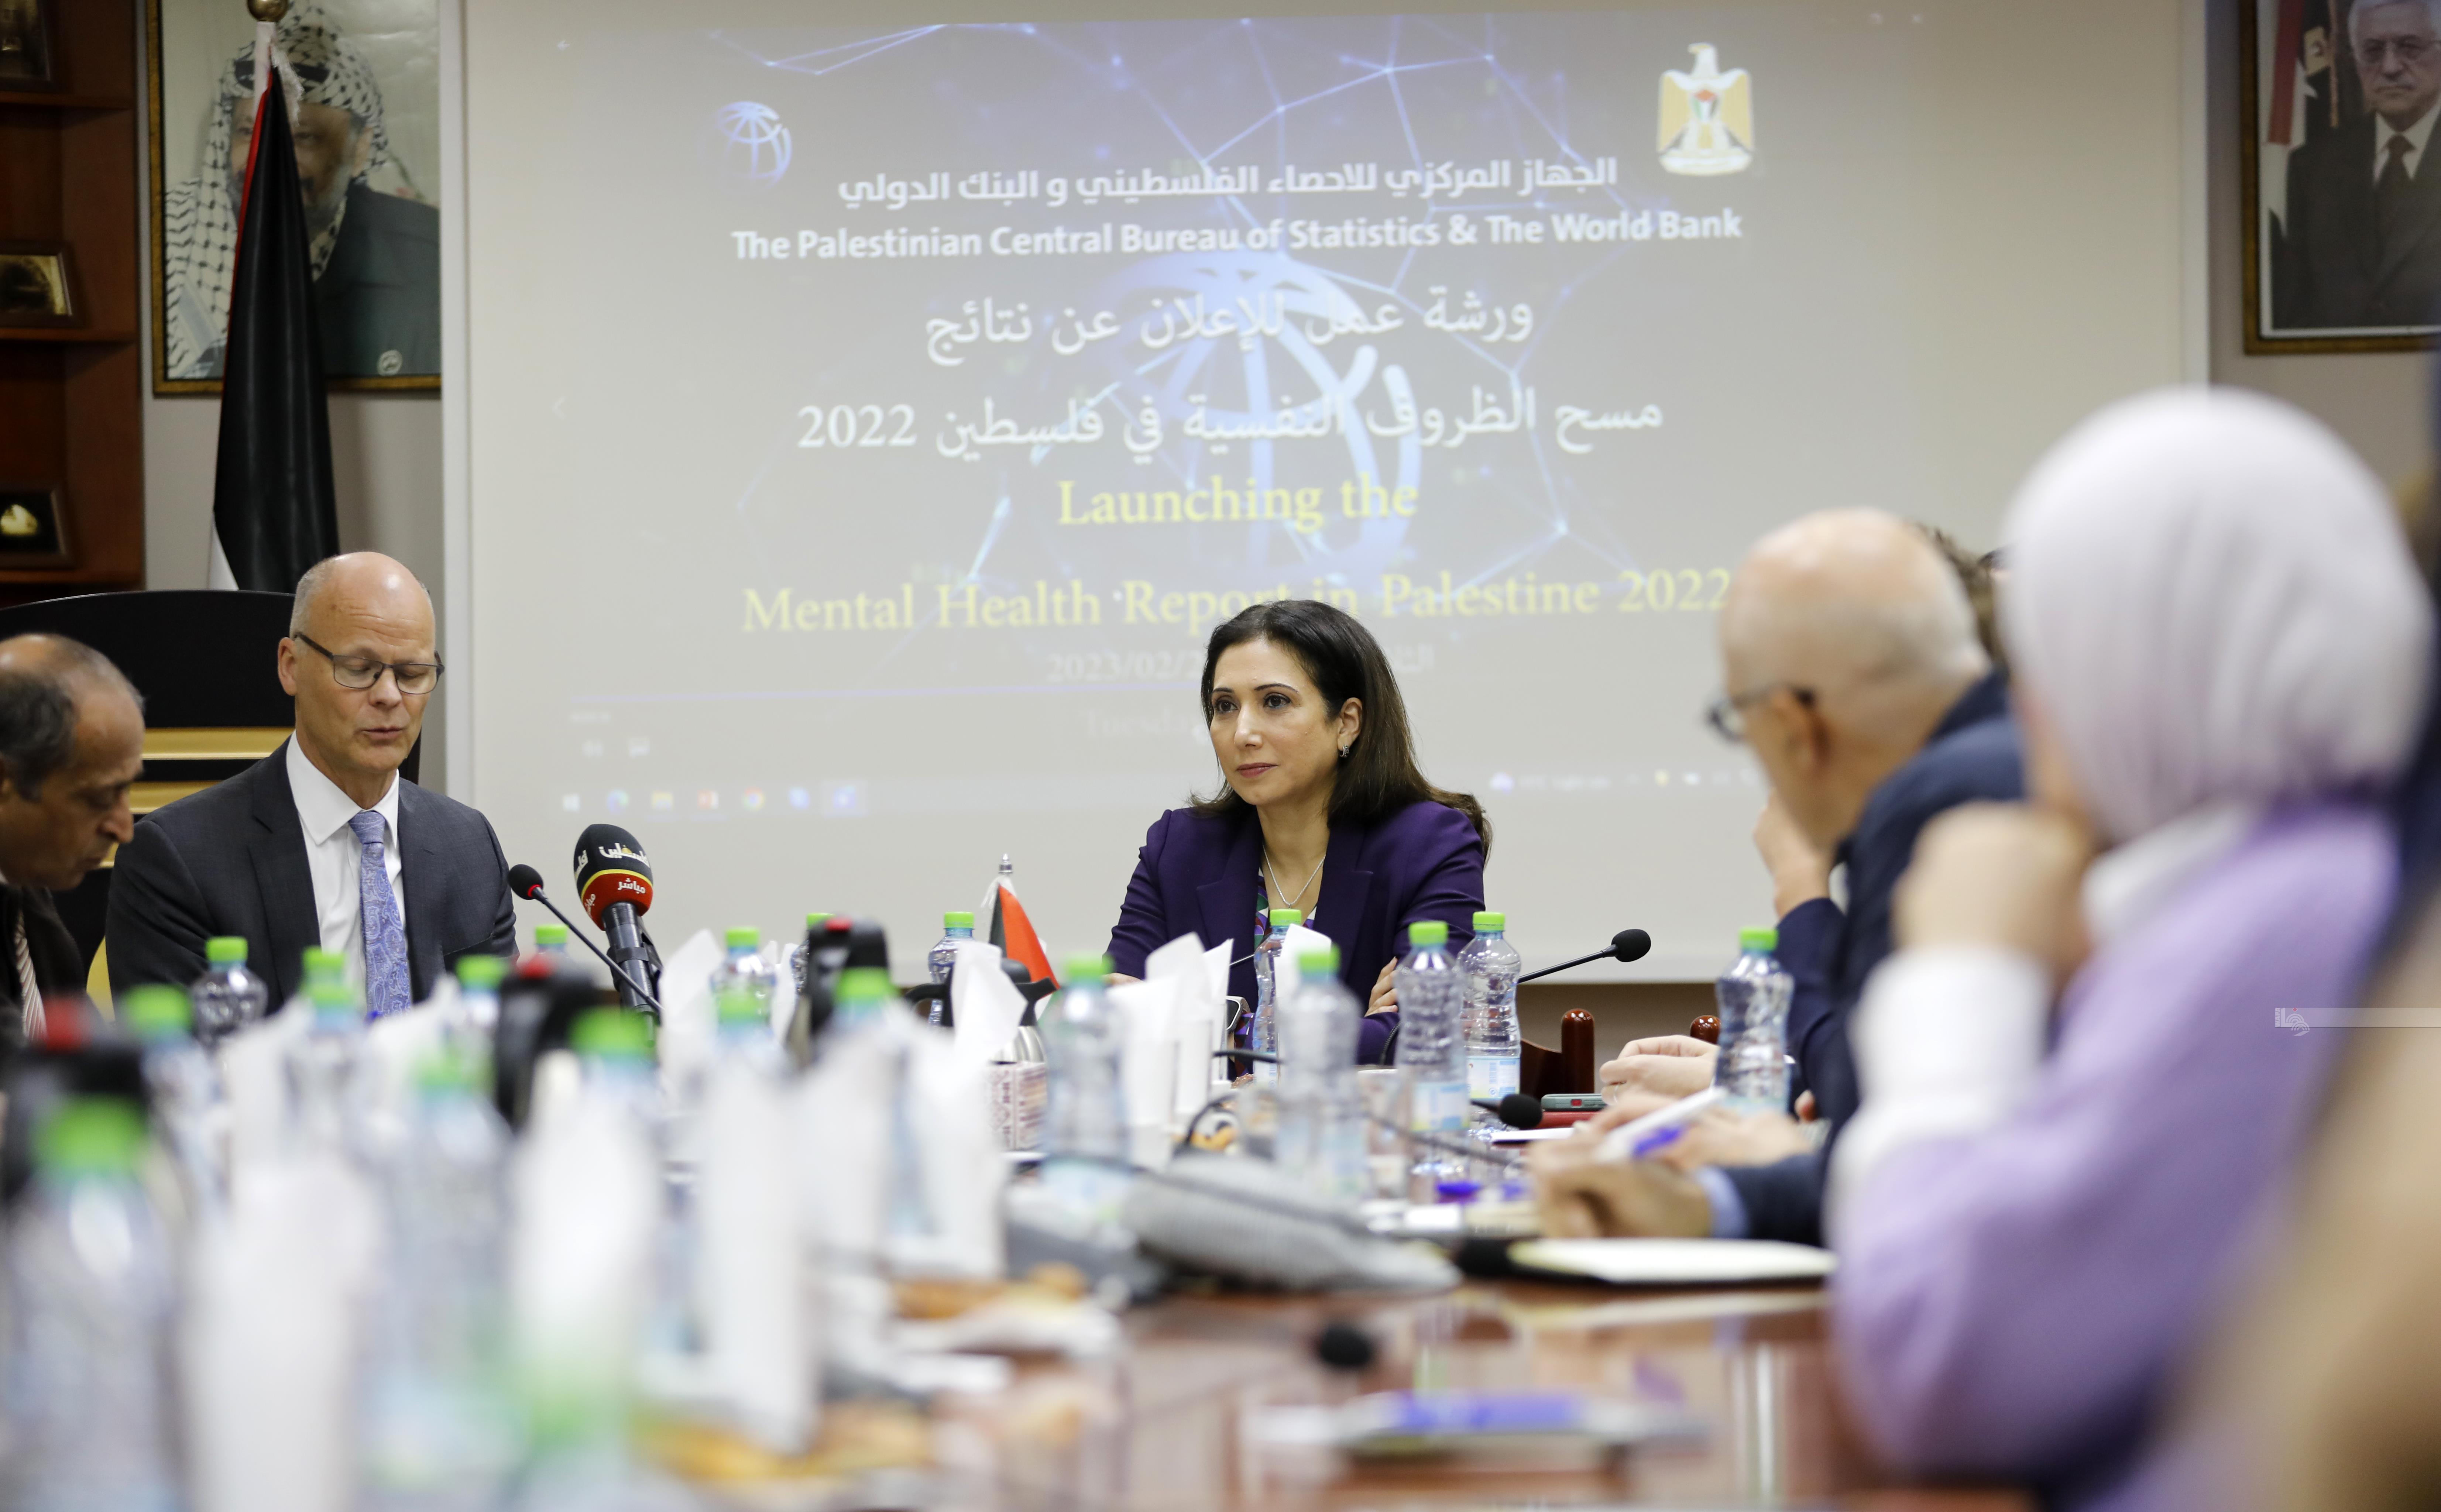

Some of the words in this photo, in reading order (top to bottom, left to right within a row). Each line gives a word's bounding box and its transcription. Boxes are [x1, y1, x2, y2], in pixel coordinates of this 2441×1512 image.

[839, 172, 948, 209] الدولي
[958, 171, 1037, 205] البنك
[1047, 178, 1067, 205] و
[1078, 165, 1257, 203] الفلسطيني
[1268, 164, 1376, 193] للاحصاء
[1384, 161, 1510, 197] المركزي
[1518, 158, 1617, 194] الجهاز
[731, 231, 790, 259] The
[798, 227, 982, 257] Palestinian
[990, 224, 1111, 254] Central
[1121, 224, 1237, 251] Bureau
[1246, 220, 1284, 251] of
[1290, 217, 1439, 248] Statistics
[1448, 214, 1477, 244] &
[1485, 214, 1544, 243] The
[1552, 210, 1650, 241] World
[1659, 209, 1742, 239] Bank
[926, 298, 1033, 367] نتائج
[1051, 307, 1120, 355] عن
[1140, 290, 1285, 351] للإعلان
[1305, 299, 1403, 344] عمل
[1424, 286, 1533, 342] ورشة
[797, 403, 917, 448] 2022
[936, 397, 1104, 461] فلسطين
[1123, 396, 1163, 464] في
[1184, 392, 1345, 454] النفسية
[1367, 386, 1536, 447] الظروف
[1556, 401, 1662, 453] مسح
[1057, 474, 1323, 533] Launching
[1340, 474, 1418, 518] the
[742, 584, 913, 633] Mental
[936, 580, 1100, 628] Health
[1312, 574, 1358, 616] in
[1381, 571, 1600, 617] Palestine
[1618, 568, 1730, 613] 2022
[618, 878, 646, 894] مباشر
